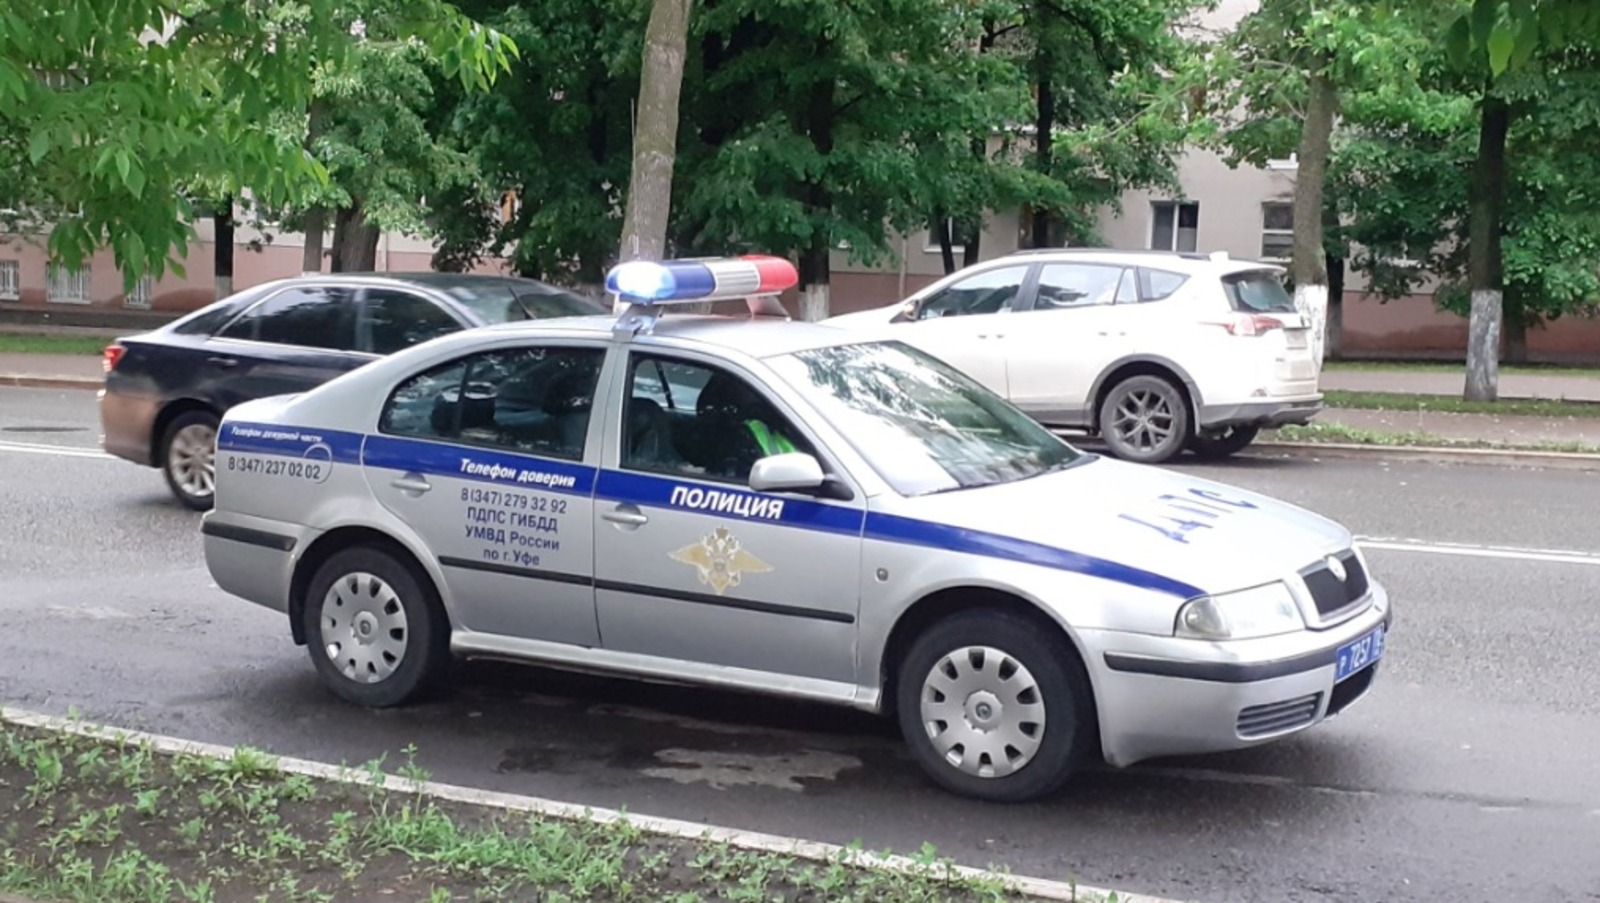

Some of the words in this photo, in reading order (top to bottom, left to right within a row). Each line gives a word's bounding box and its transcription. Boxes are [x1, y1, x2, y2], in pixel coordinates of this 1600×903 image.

[266, 460, 286, 475] 237
[288, 462, 303, 477] 02
[305, 464, 321, 480] 02
[460, 458, 516, 479] Телефон
[518, 469, 575, 487] доверия
[504, 493, 528, 510] 279
[530, 497, 547, 512] 32
[550, 499, 567, 514] 92
[670, 486, 785, 519] ПОЛИЦИЯ
[467, 506, 507, 525] ПДПС
[510, 512, 558, 533] ГИБДД
[465, 525, 506, 544] УМВД
[510, 531, 560, 551] России
[483, 549, 500, 560] по
